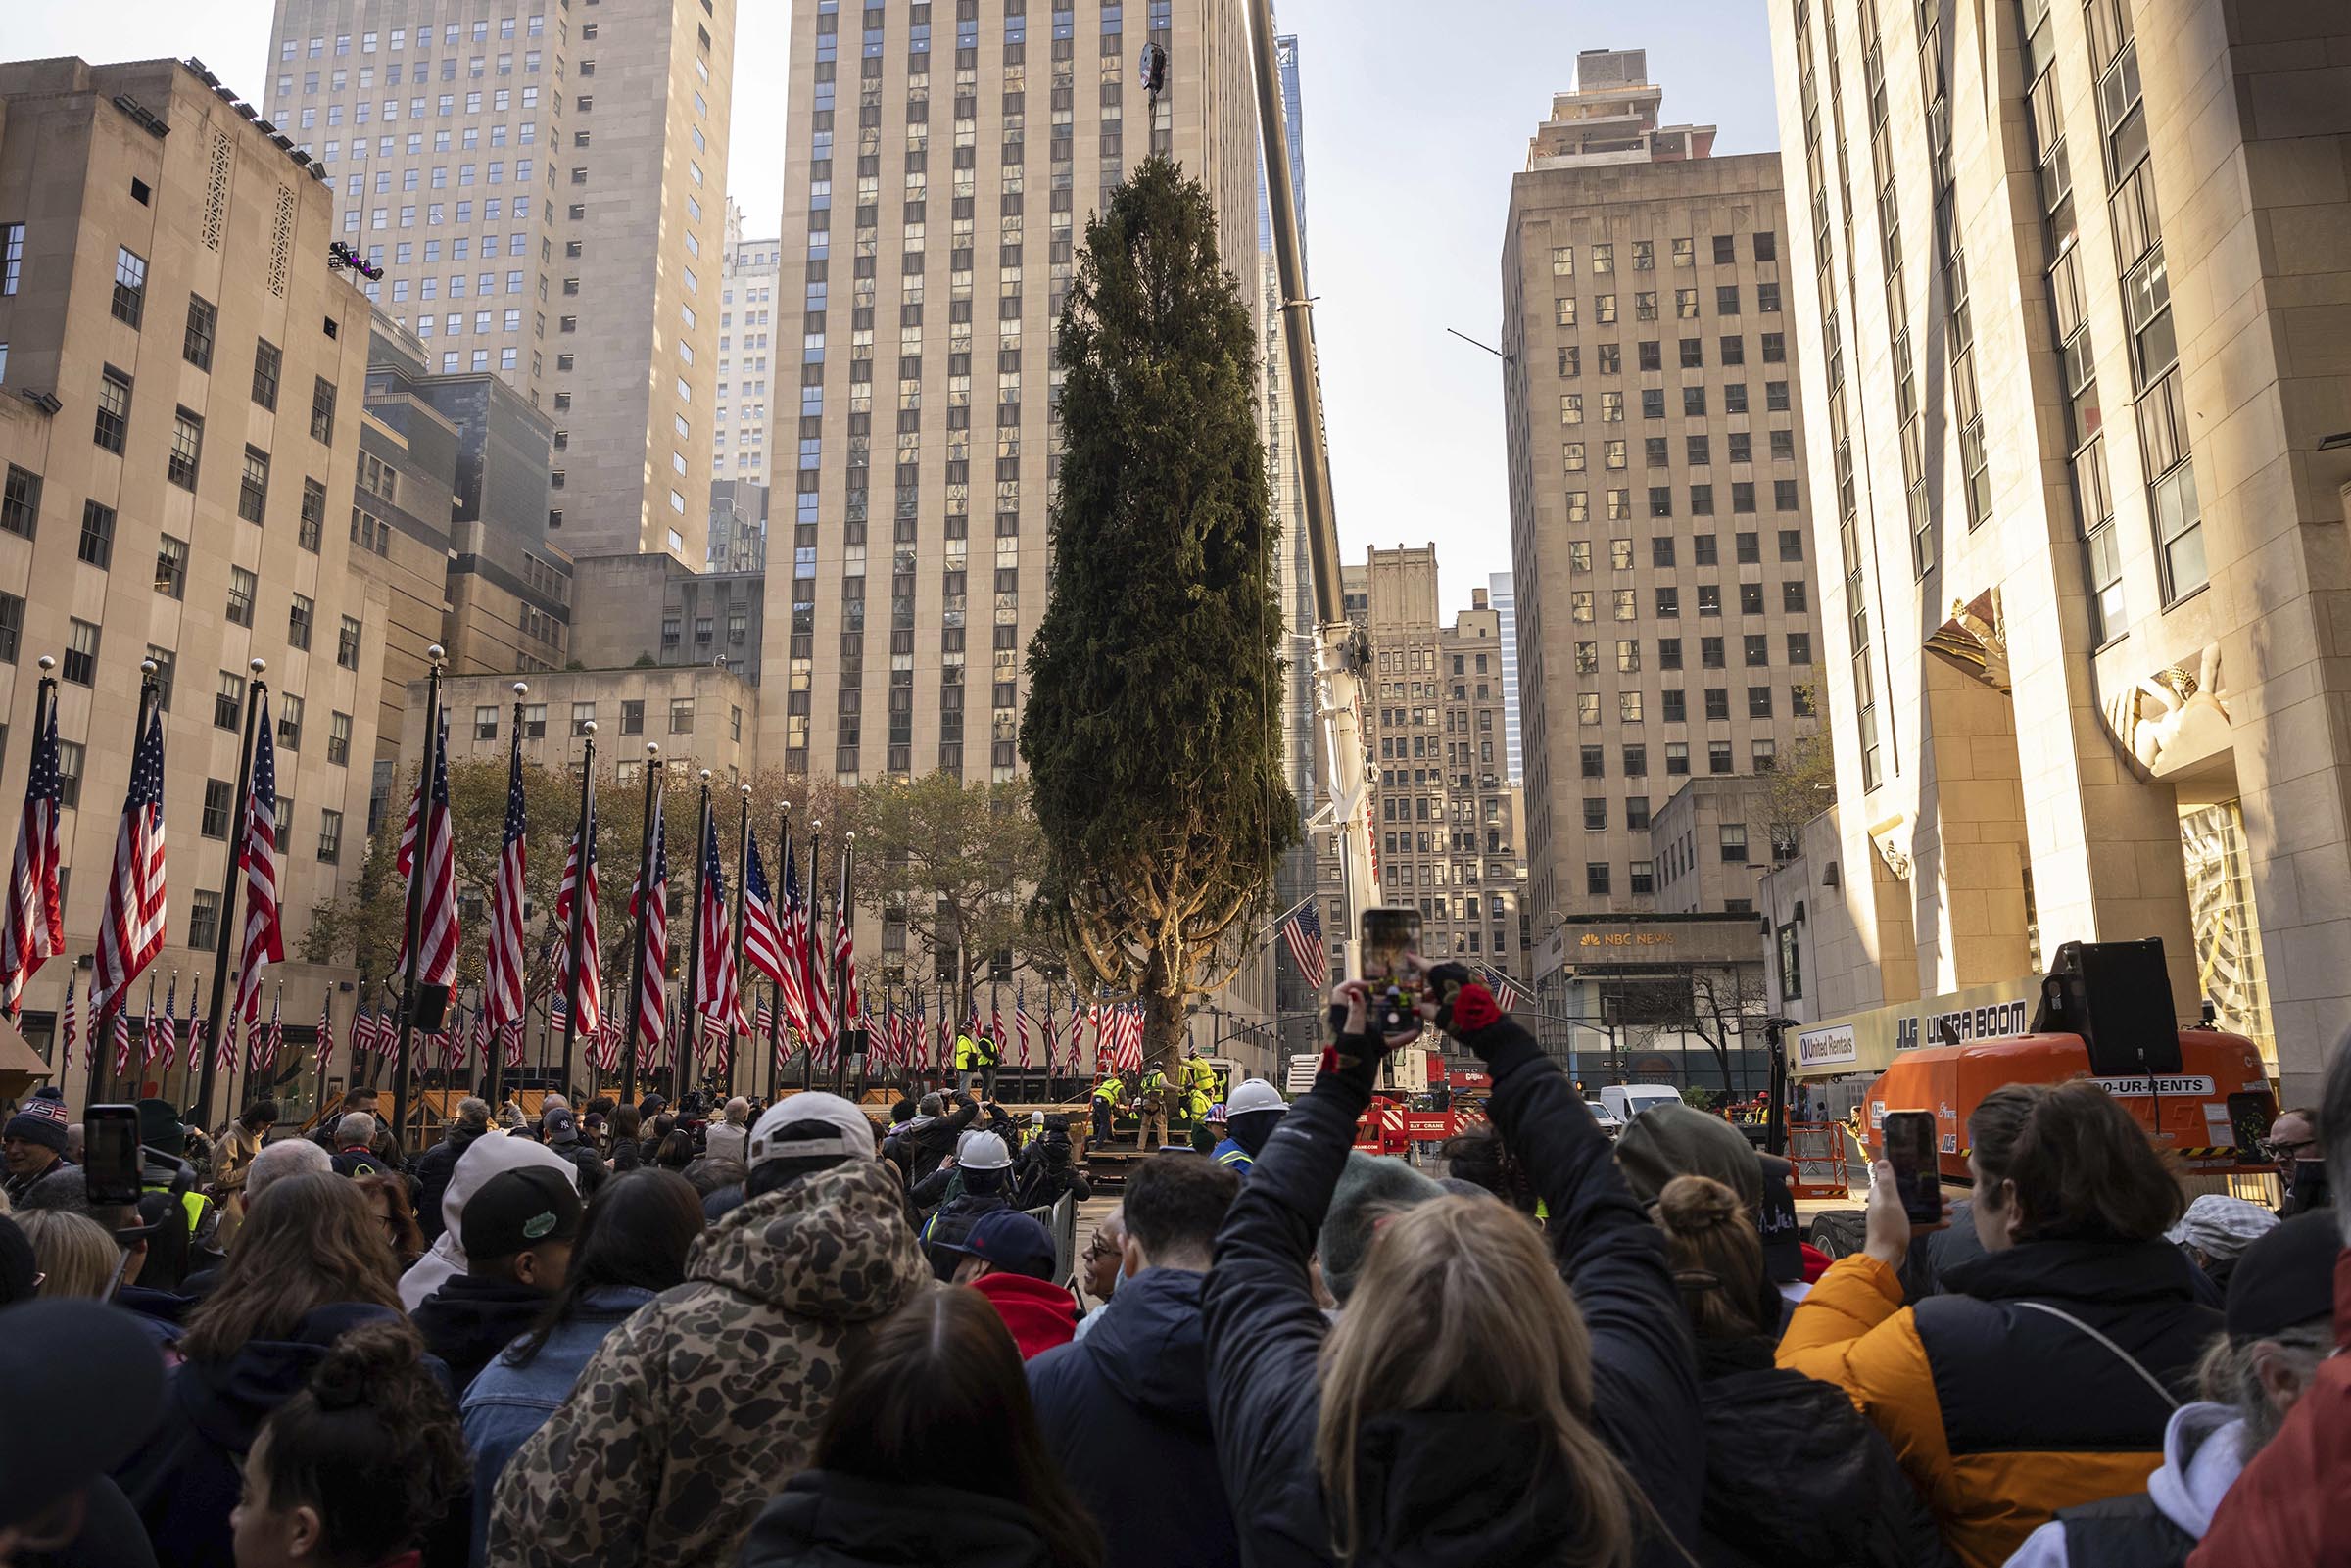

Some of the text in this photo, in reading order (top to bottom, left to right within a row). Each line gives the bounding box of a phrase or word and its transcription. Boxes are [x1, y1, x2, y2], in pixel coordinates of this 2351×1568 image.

[1605, 933, 1675, 946] NBC NEWS
[1896, 1017, 1918, 1049] JLG
[1976, 1002, 2026, 1038] BOOM
[1807, 1032, 1853, 1058] United Rentals
